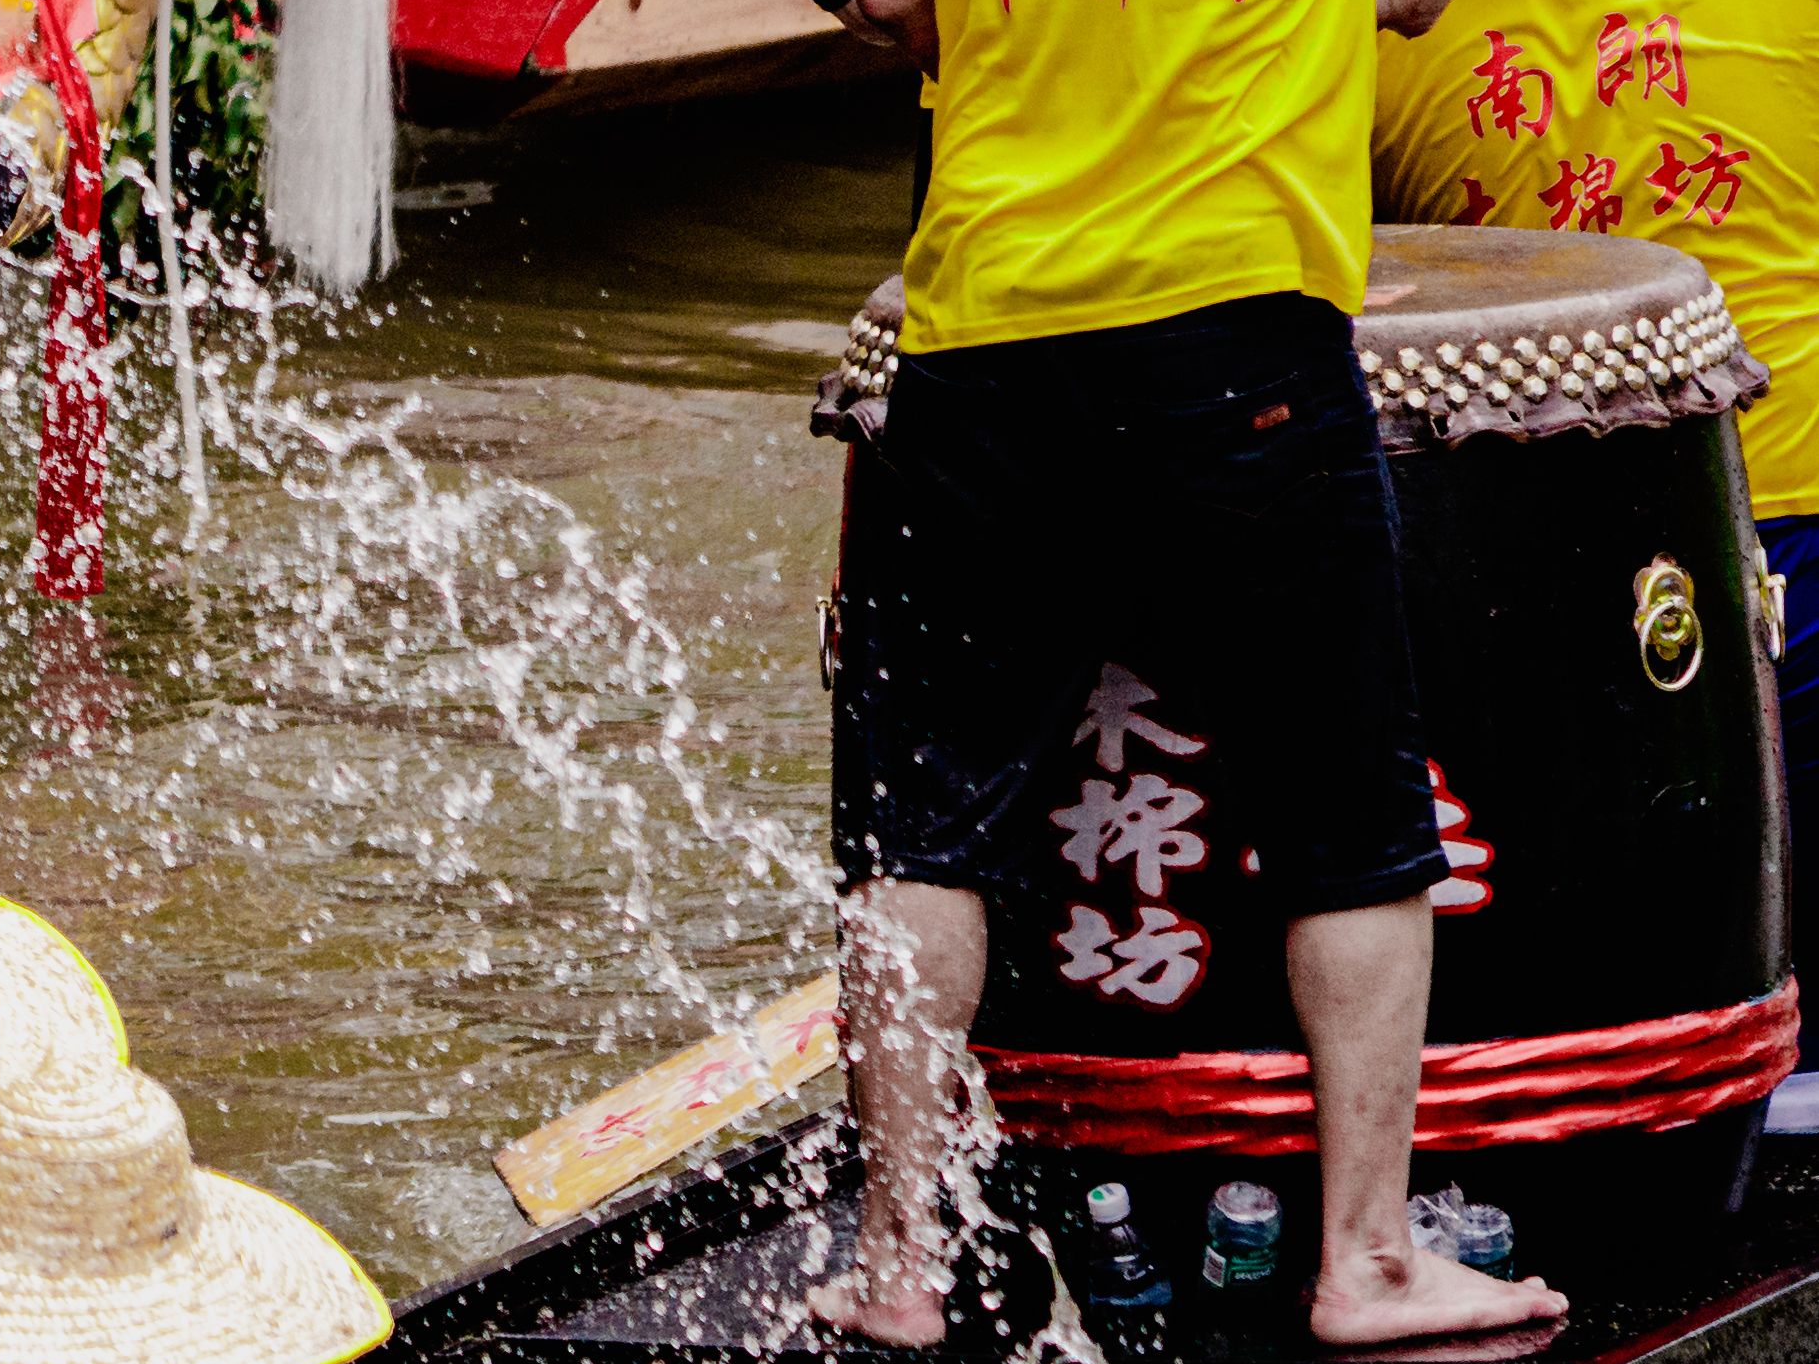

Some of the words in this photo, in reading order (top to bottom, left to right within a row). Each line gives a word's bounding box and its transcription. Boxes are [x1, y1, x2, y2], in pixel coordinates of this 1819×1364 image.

[1465, 12, 1689, 141] 南朗
[1048, 661, 1212, 1008] 木棉坊
